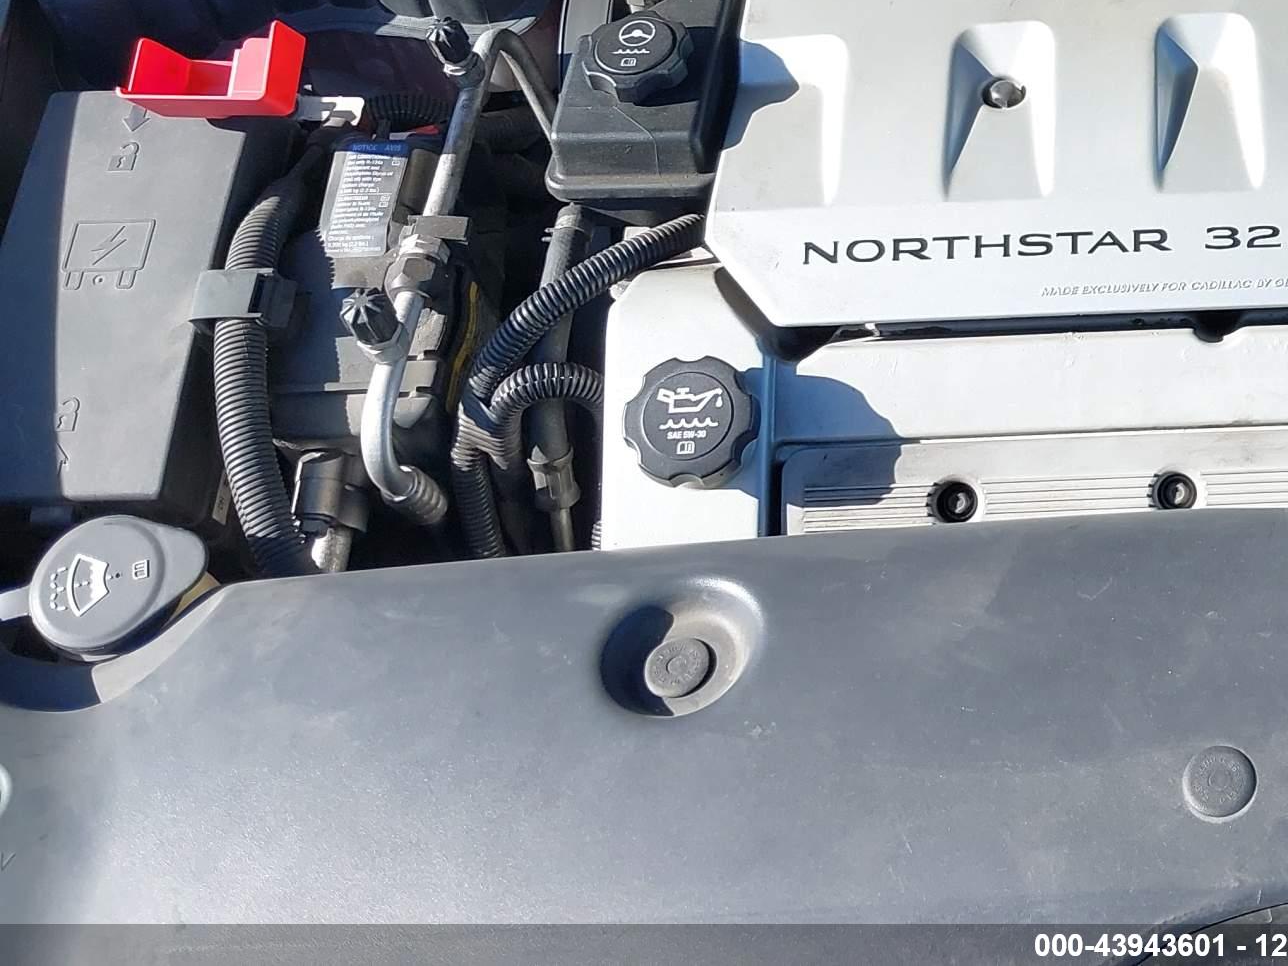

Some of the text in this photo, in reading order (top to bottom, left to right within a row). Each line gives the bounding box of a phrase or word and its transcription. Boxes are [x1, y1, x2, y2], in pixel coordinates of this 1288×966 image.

[802, 228, 1173, 265] NORTHSTAR
[1204, 225, 1282, 249] 32
[1041, 286, 1080, 297] MADE
[1081, 283, 1160, 295] EXCLUSIVELY
[1161, 281, 1188, 292] FOR
[1191, 280, 1252, 291] CADILLAC
[1256, 278, 1273, 288] BY
[666, 429, 707, 439] SAE 5W-30
